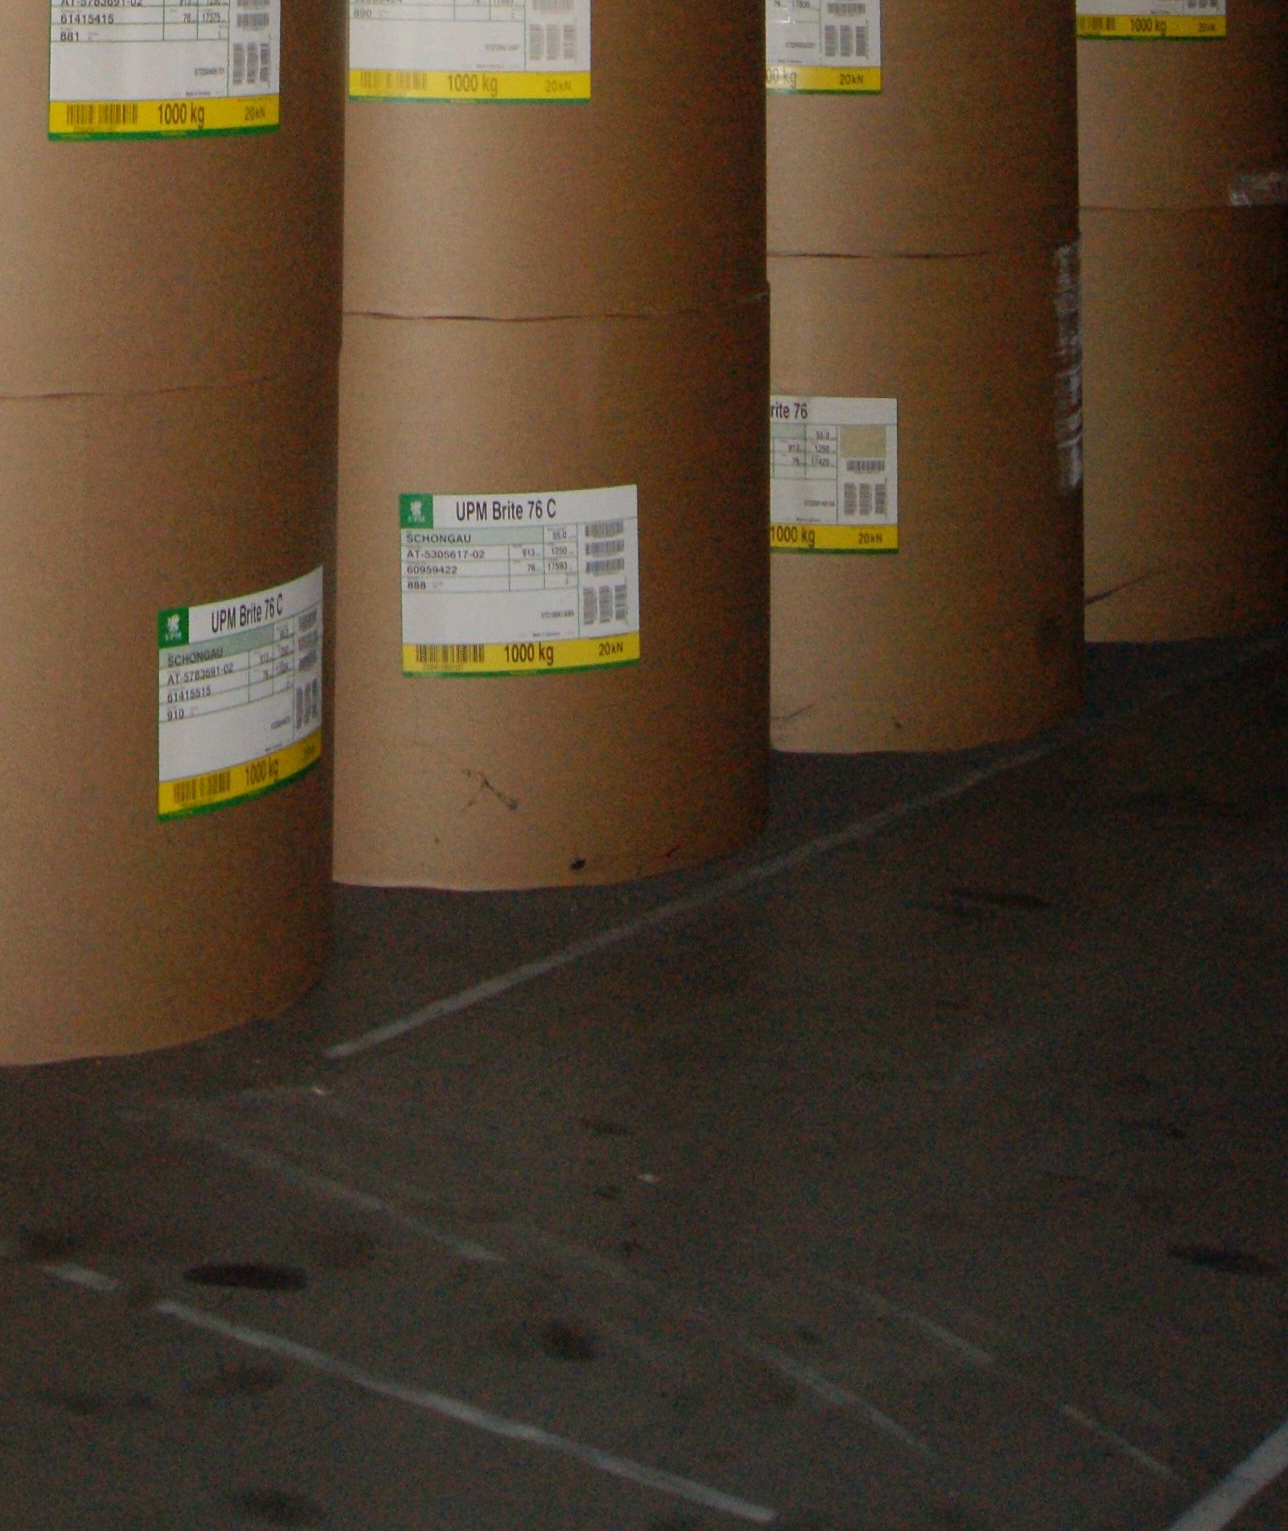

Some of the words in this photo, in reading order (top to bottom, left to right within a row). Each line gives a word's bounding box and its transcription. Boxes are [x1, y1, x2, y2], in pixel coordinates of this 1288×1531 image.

[60, 14, 114, 24] 61415415
[158, 103, 187, 124] 1000
[191, 104, 205, 129] kg
[771, 402, 789, 419] rite
[794, 403, 807, 419] 76
[456, 501, 487, 521] UPM
[493, 501, 523, 520] Brite
[528, 500, 542, 519] 76
[547, 499, 556, 518] C
[407, 534, 471, 543] SCHONGAU
[504, 644, 534, 662] 1000
[539, 643, 554, 666] kg
